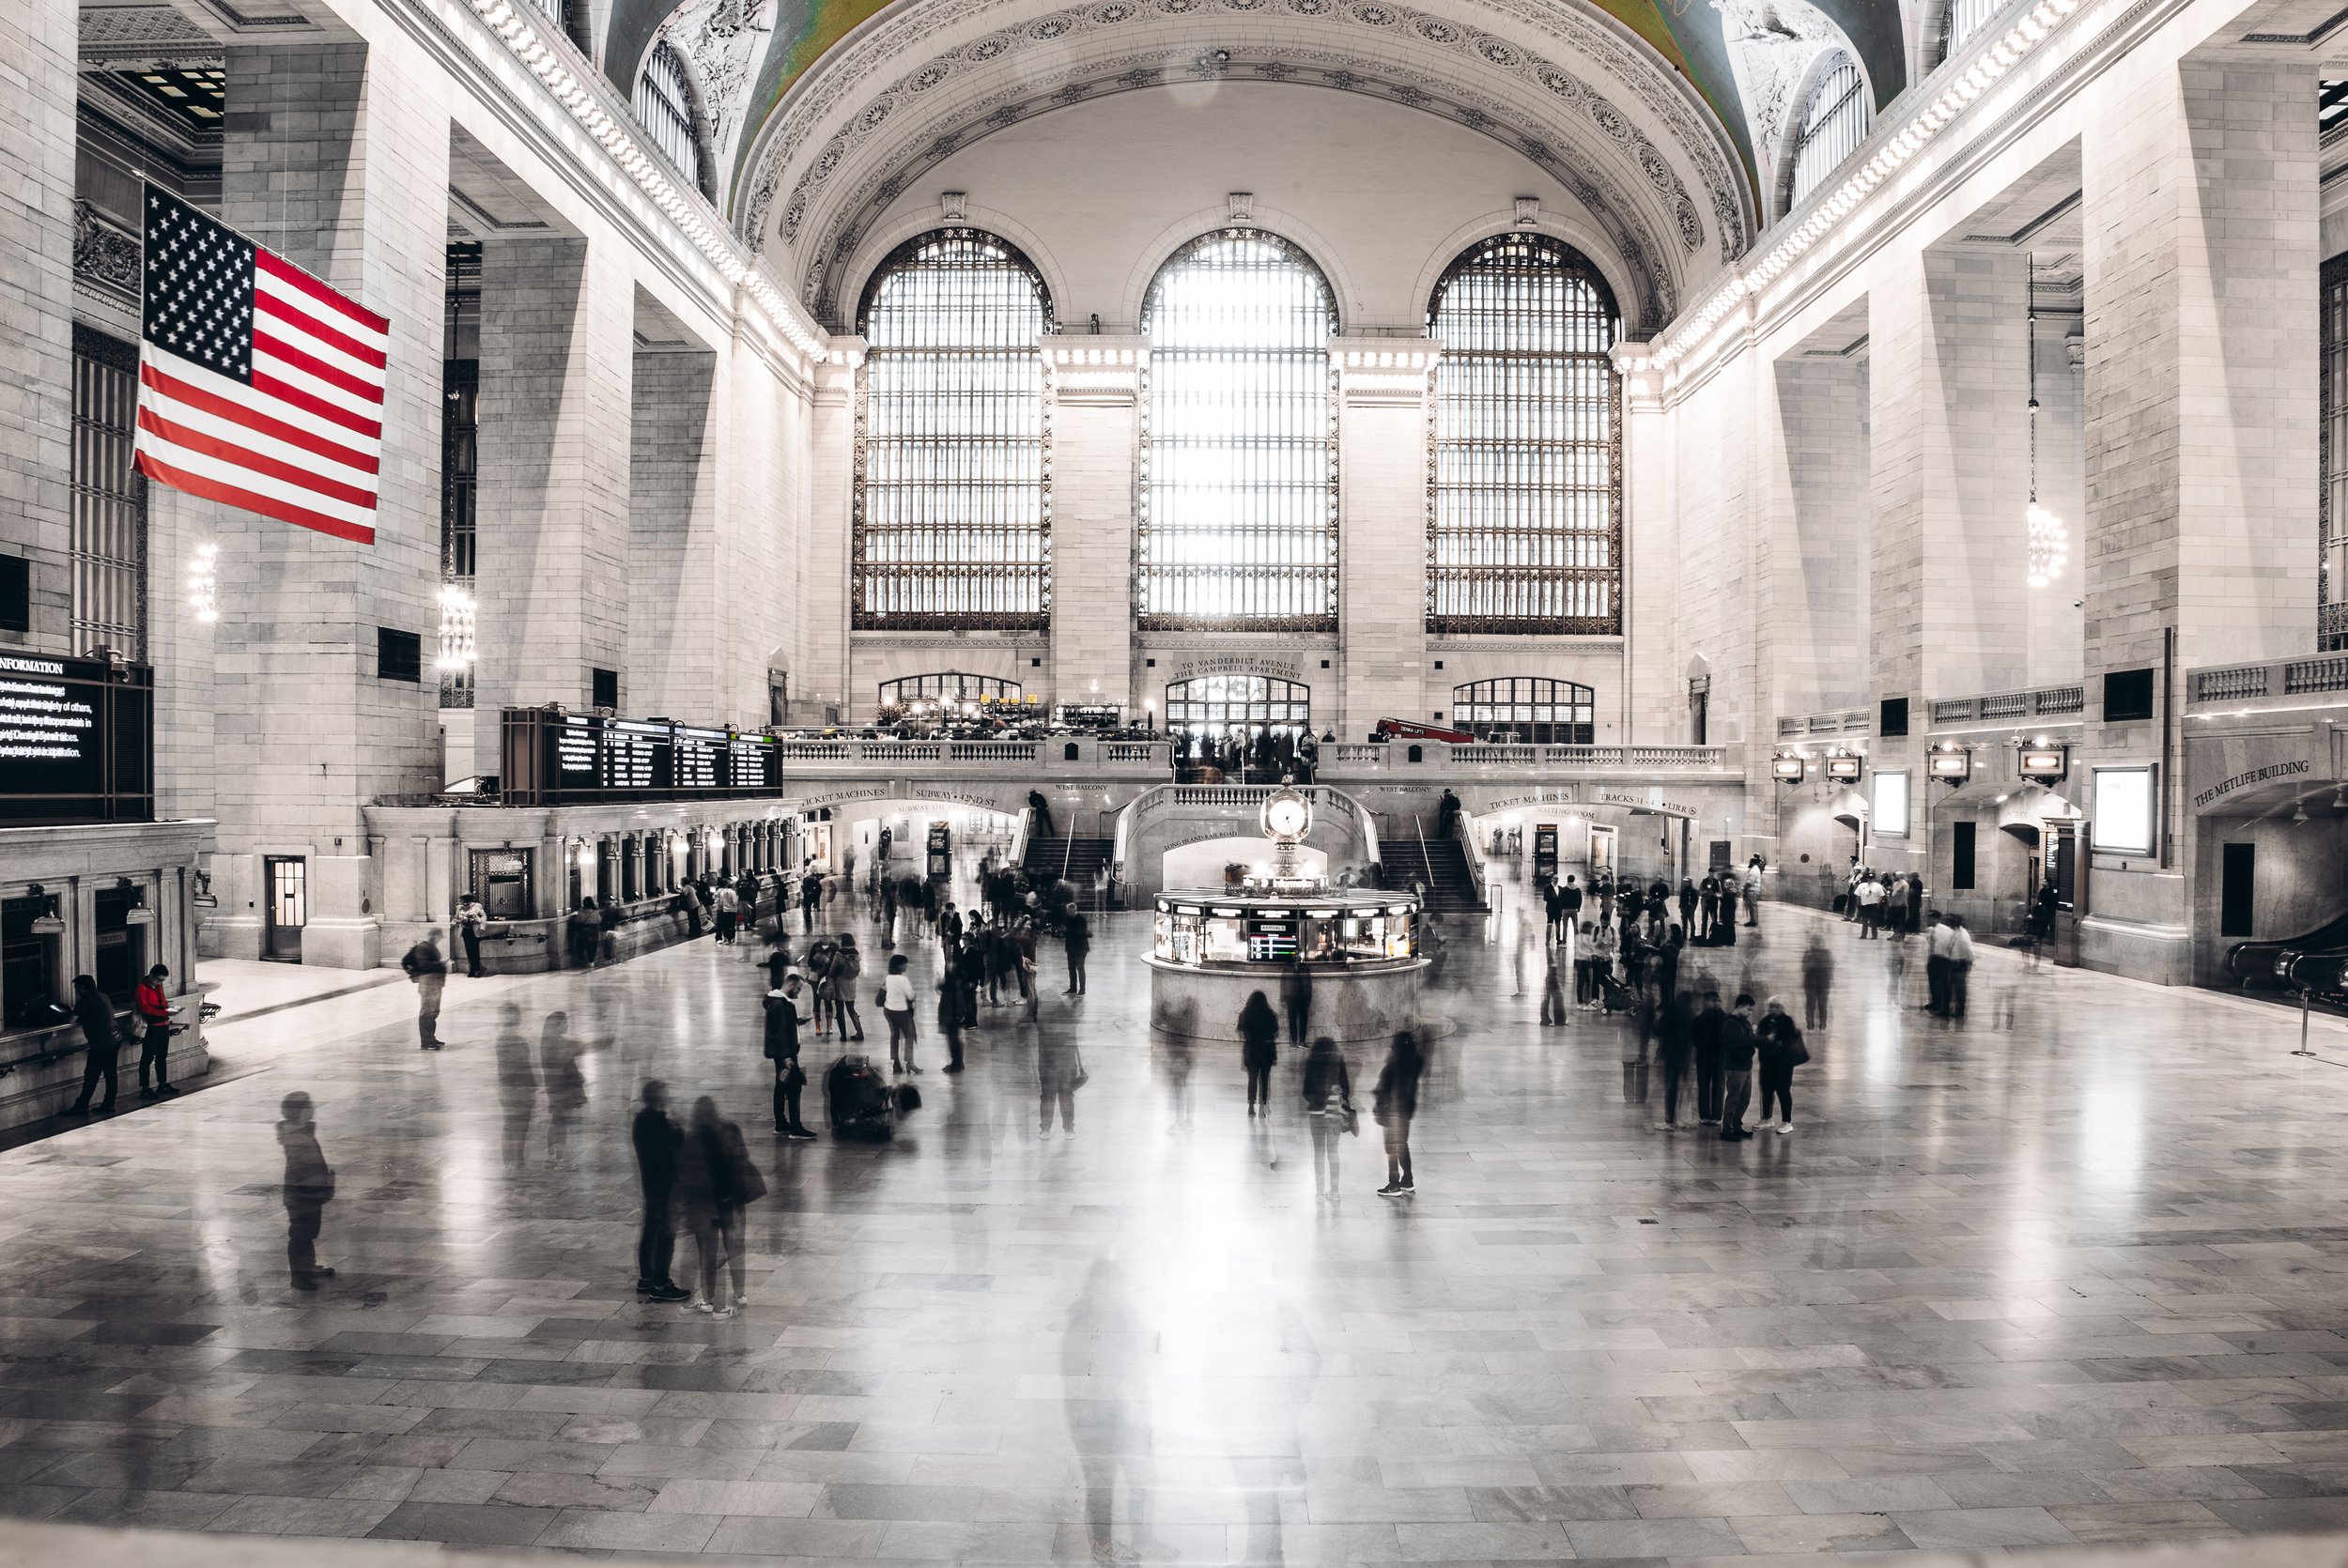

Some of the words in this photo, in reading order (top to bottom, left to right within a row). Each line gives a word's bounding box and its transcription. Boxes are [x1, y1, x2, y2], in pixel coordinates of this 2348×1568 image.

[1181, 661, 1194, 669] TO
[1198, 657, 1255, 666] VANDERBILT
[1259, 659, 1296, 670] AVENUE
[1174, 669, 1194, 679] THE
[1197, 665, 1244, 674] CAMPBELL
[1249, 666, 1302, 680] APARTMENT
[2194, 789, 2215, 807] THE
[2215, 770, 2256, 797] METLIFE
[2258, 760, 2309, 781] BUILDING
[836, 789, 886, 799] MACHINES
[916, 790, 952, 799] SUBWAY
[960, 793, 983, 805] 42ND
[985, 798, 997, 807] ST
[1490, 797, 1520, 809] TICKET
[1523, 792, 1569, 804] MACHINES
[898, 804, 930, 812] SUBWAY
[1599, 793, 1634, 804] TRACKS
[1667, 802, 1687, 813] LIRR
[1536, 807, 1570, 815] WAITING
[1572, 809, 1595, 819] ROOM
[1164, 839, 1182, 851] LONG
[1182, 836, 1204, 845] ISLAND
